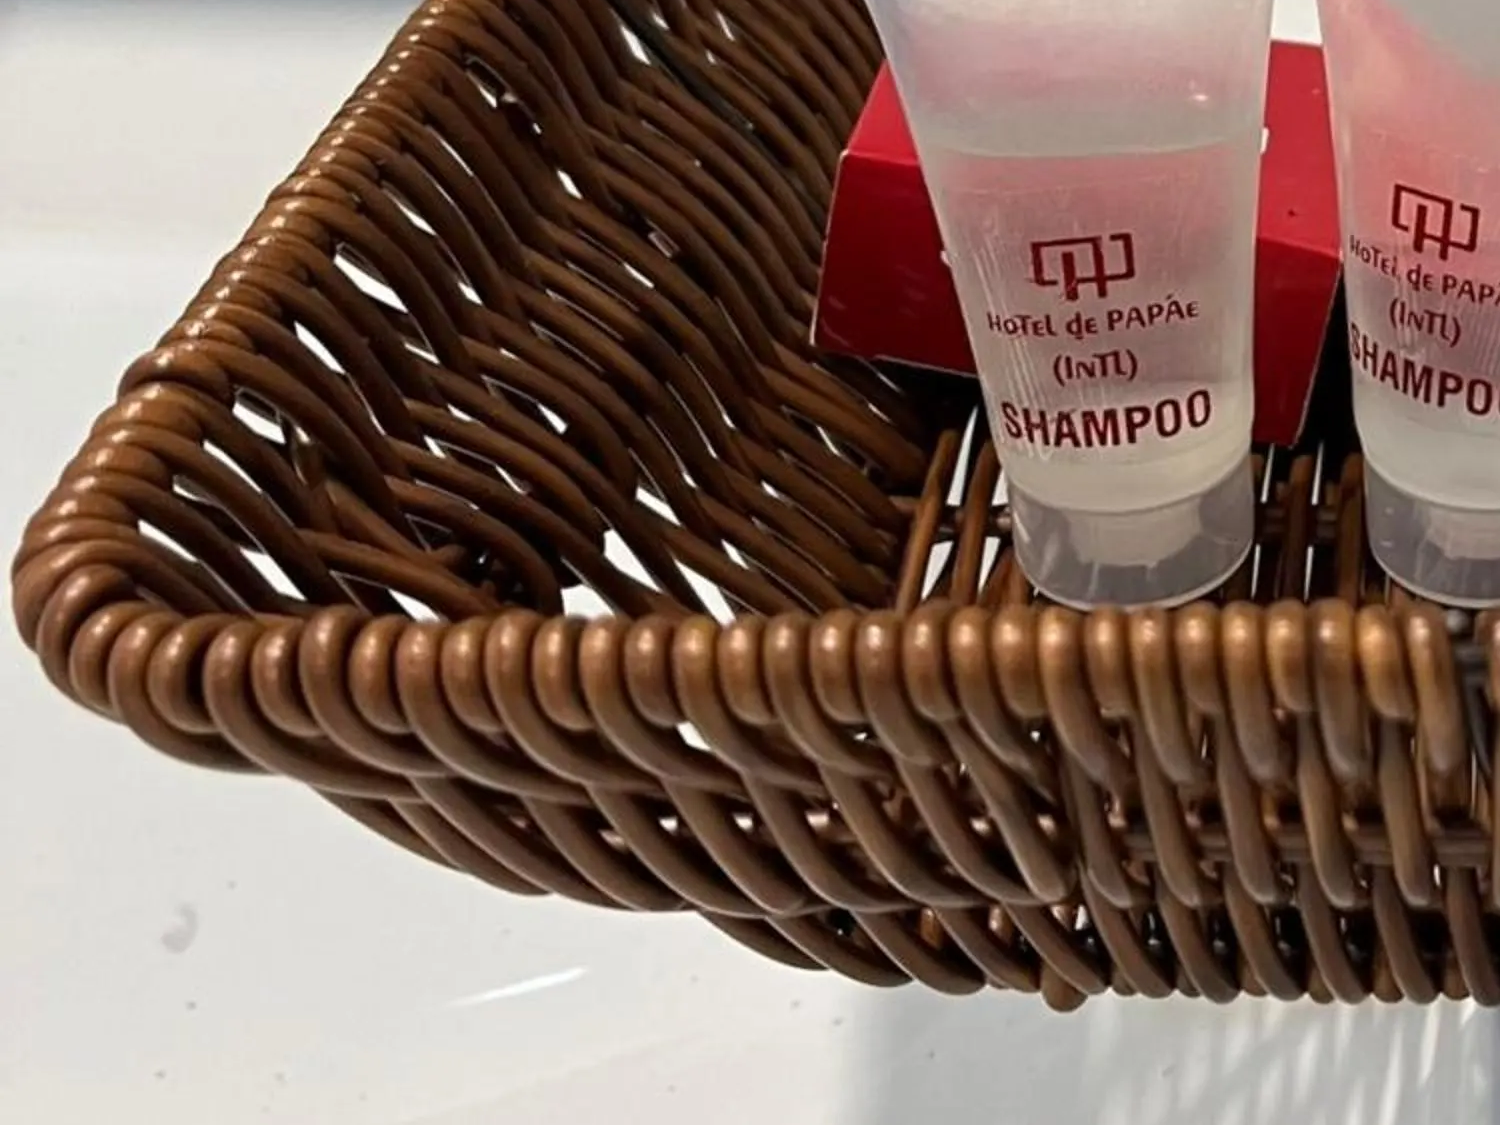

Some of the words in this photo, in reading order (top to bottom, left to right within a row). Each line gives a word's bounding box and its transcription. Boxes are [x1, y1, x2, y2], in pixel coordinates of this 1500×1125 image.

[1389, 297, 1461, 348] (INTL)
[1053, 349, 1139, 387] (INTL)
[1001, 388, 1212, 449] SHAMPOO
